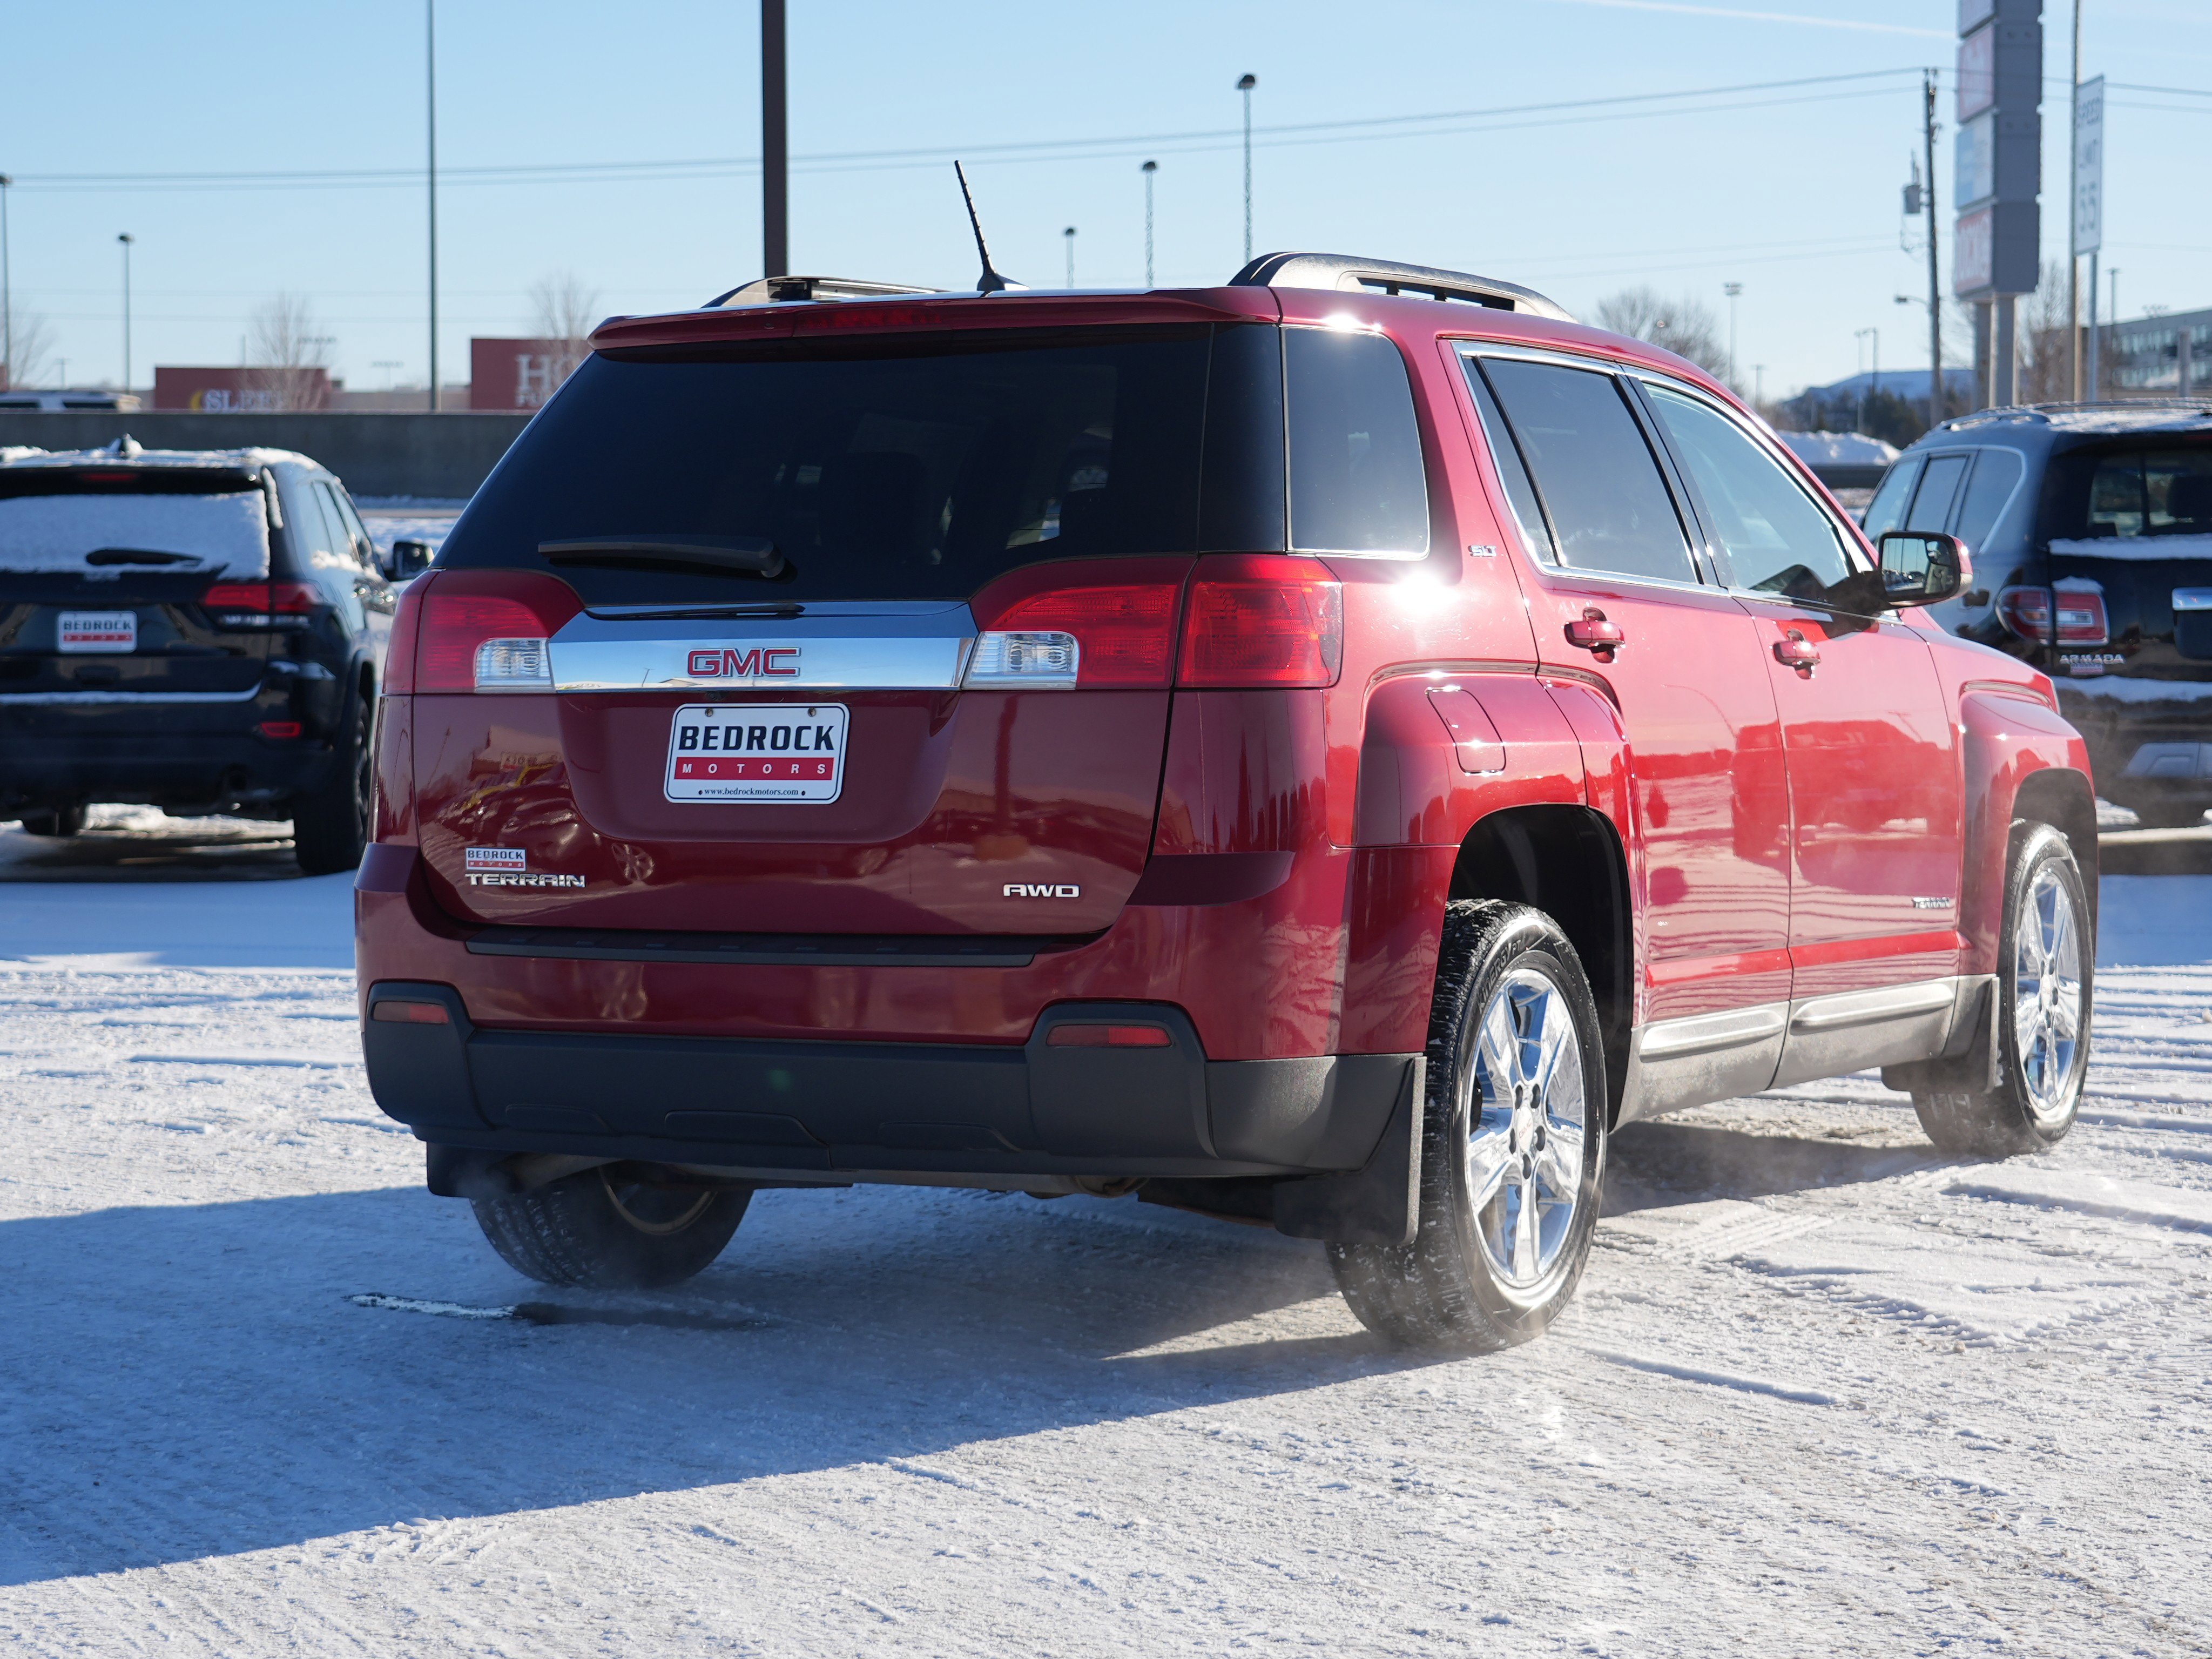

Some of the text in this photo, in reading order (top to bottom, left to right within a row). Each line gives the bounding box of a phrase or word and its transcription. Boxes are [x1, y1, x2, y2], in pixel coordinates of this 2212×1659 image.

[64, 621, 132, 630] BEDROCK
[687, 647, 801, 677] GMC
[2059, 654, 2125, 664] ARMADA
[678, 725, 834, 751] BEDROCK
[682, 763, 826, 774] MOTORS
[704, 787, 799, 796] www.bedrockmotors.com
[468, 850, 523, 859] BEDROCK
[465, 873, 585, 887] TERRAIN
[1003, 884, 1080, 898] AWD
